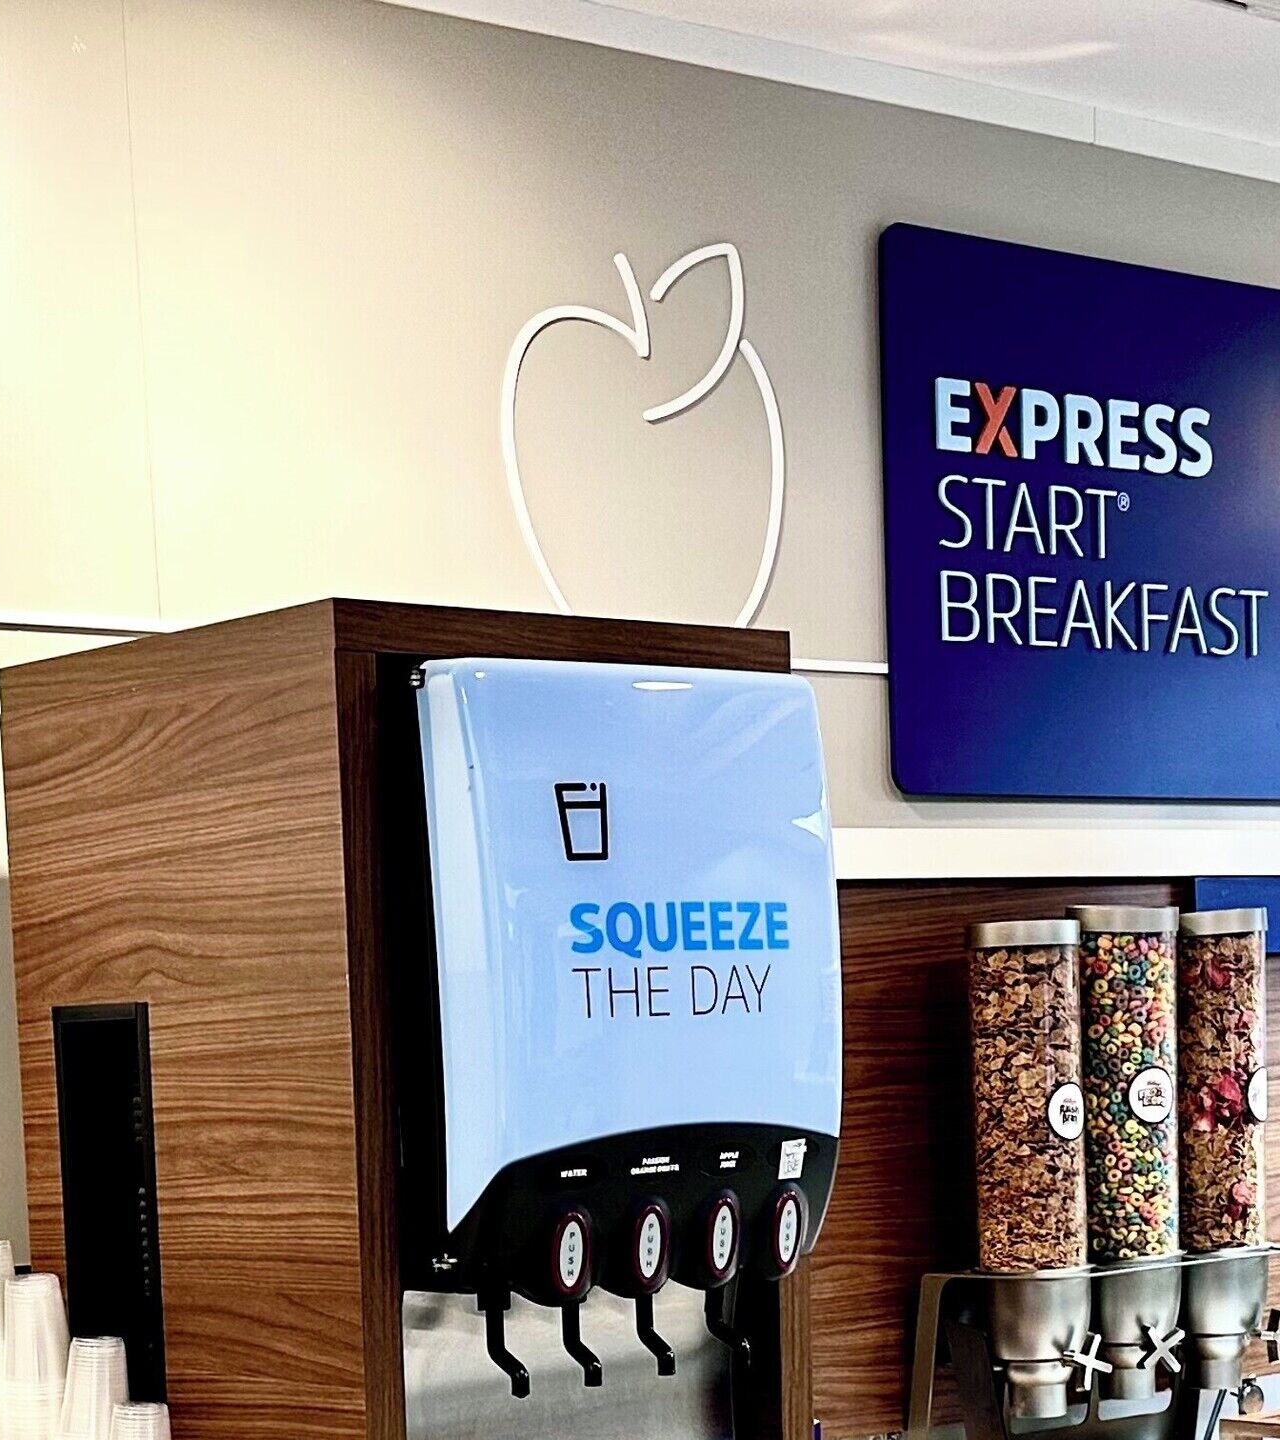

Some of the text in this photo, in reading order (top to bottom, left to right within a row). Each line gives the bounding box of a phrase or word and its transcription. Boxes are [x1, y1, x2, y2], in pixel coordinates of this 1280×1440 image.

[934, 377, 1214, 478] EXPRESS
[939, 569, 1270, 657] BREAKFAST
[569, 900, 790, 959] SQUEEZE
[571, 963, 772, 1019] THE DAY
[560, 1168, 588, 1178] WATER
[566, 1231, 576, 1277] PUSH
[646, 1223, 655, 1268] PUSH
[718, 1214, 727, 1259] PUSH
[783, 1209, 792, 1254] PUSH
